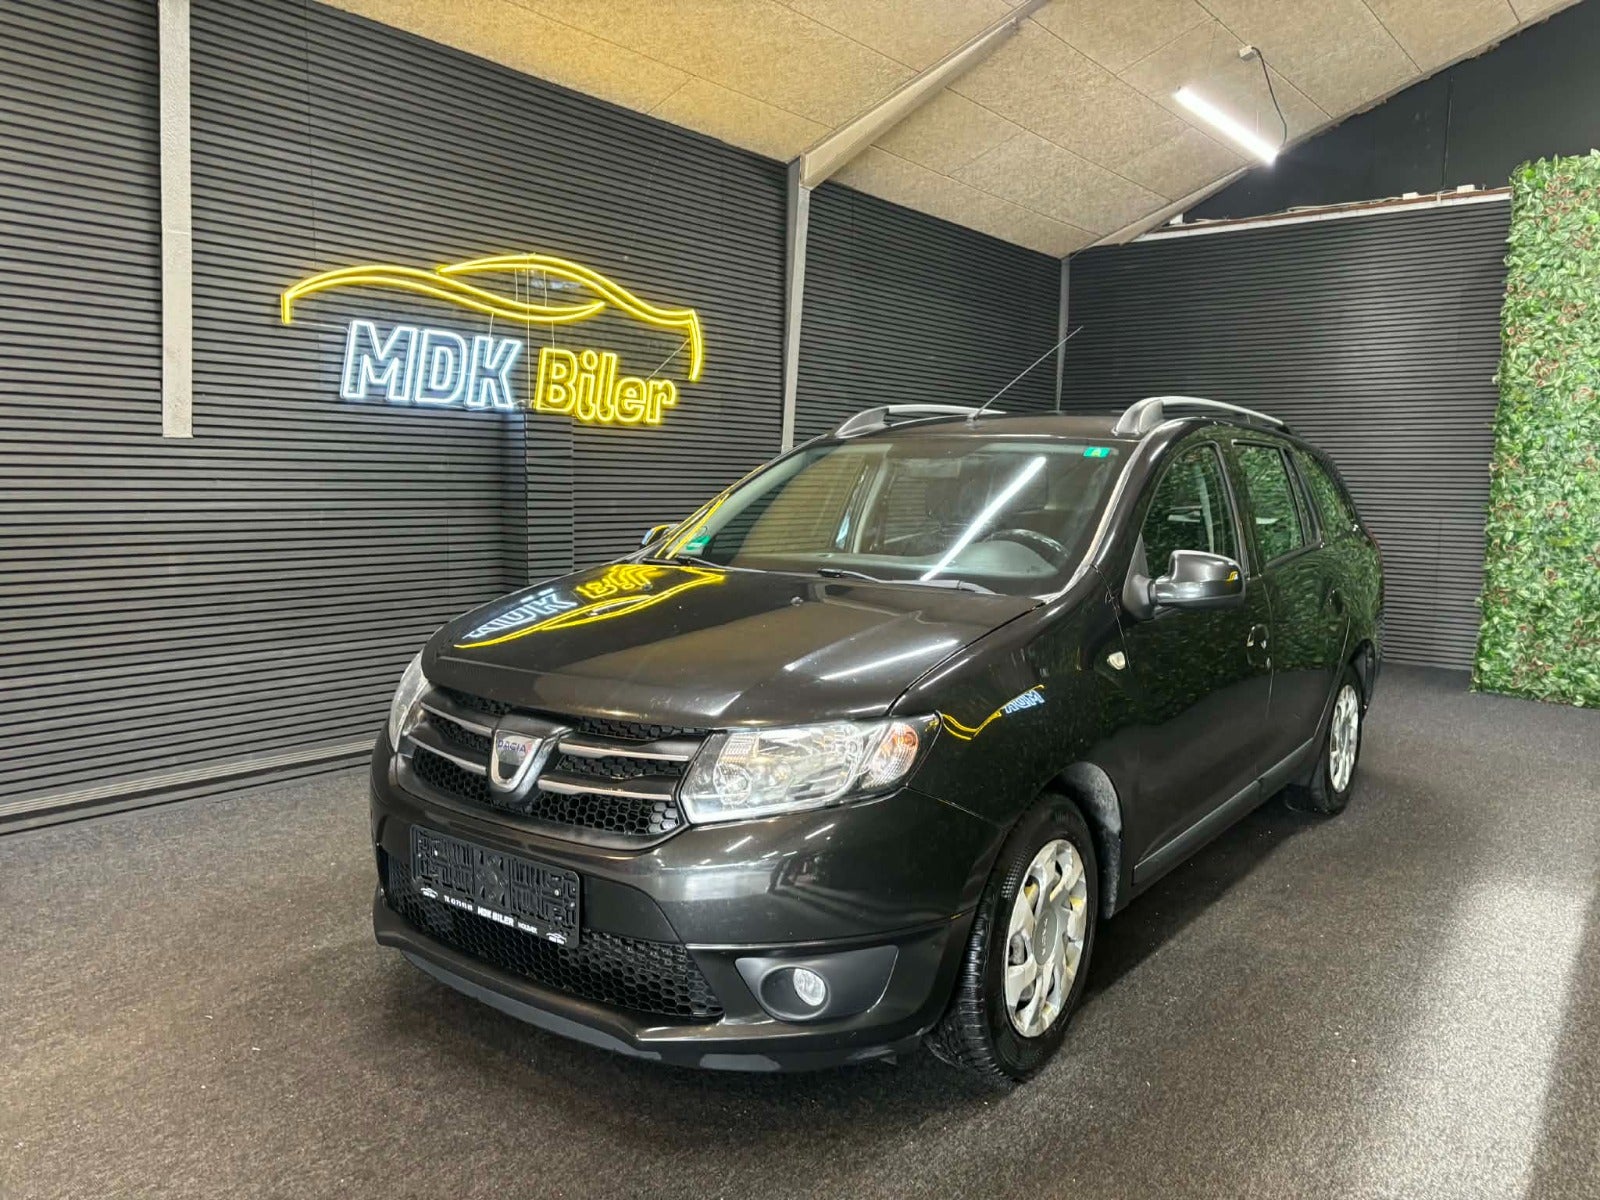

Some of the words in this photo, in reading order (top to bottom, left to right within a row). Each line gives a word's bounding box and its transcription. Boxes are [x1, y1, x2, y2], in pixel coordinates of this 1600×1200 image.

[341, 319, 523, 410] MDK
[534, 347, 676, 424] Biler
[498, 740, 526, 753] DACIA
[492, 912, 514, 927] BILER
